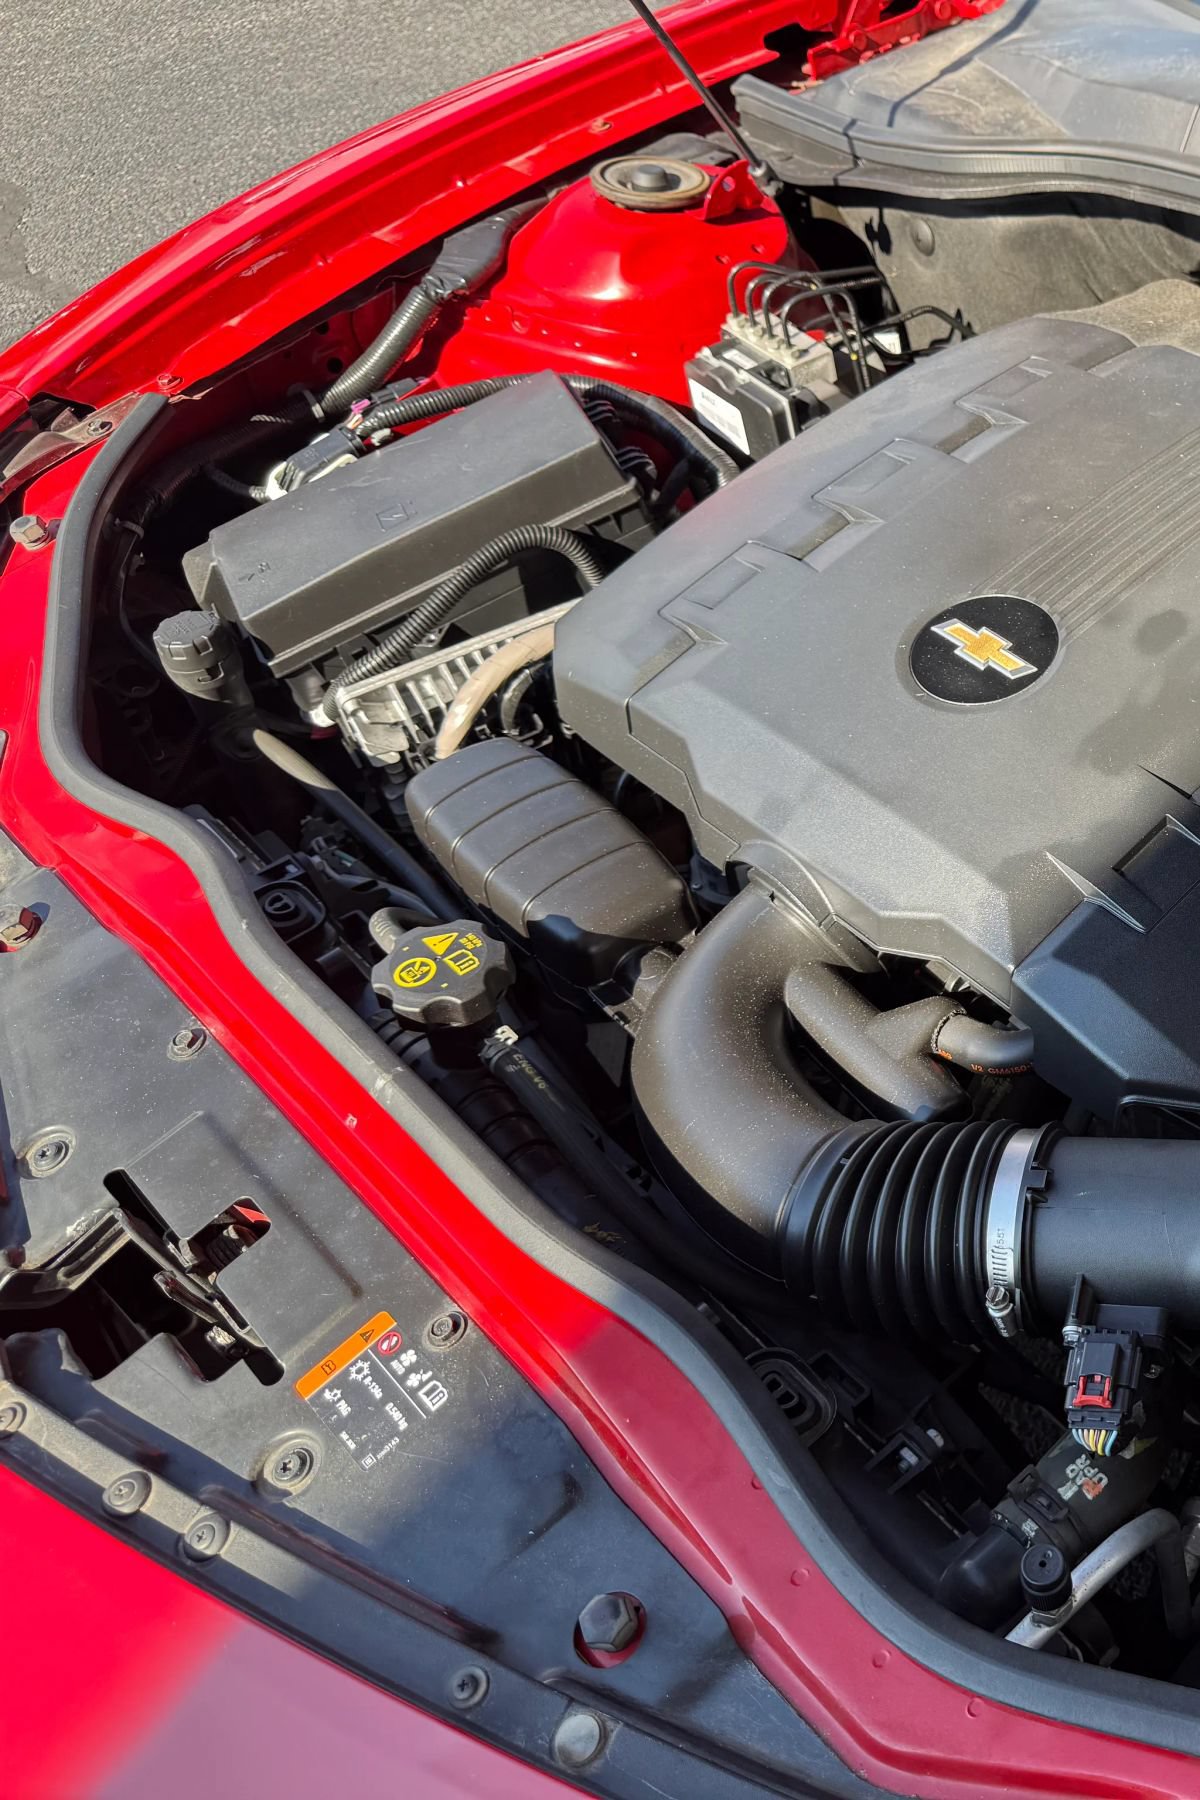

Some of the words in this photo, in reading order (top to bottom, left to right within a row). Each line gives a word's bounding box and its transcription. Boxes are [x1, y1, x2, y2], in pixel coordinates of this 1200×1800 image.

[390, 1359, 406, 1375] AUTO
[363, 1376, 383, 1399] R-134a
[336, 1399, 352, 1417] PAG
[1075, 1453, 1108, 1488] UPR
